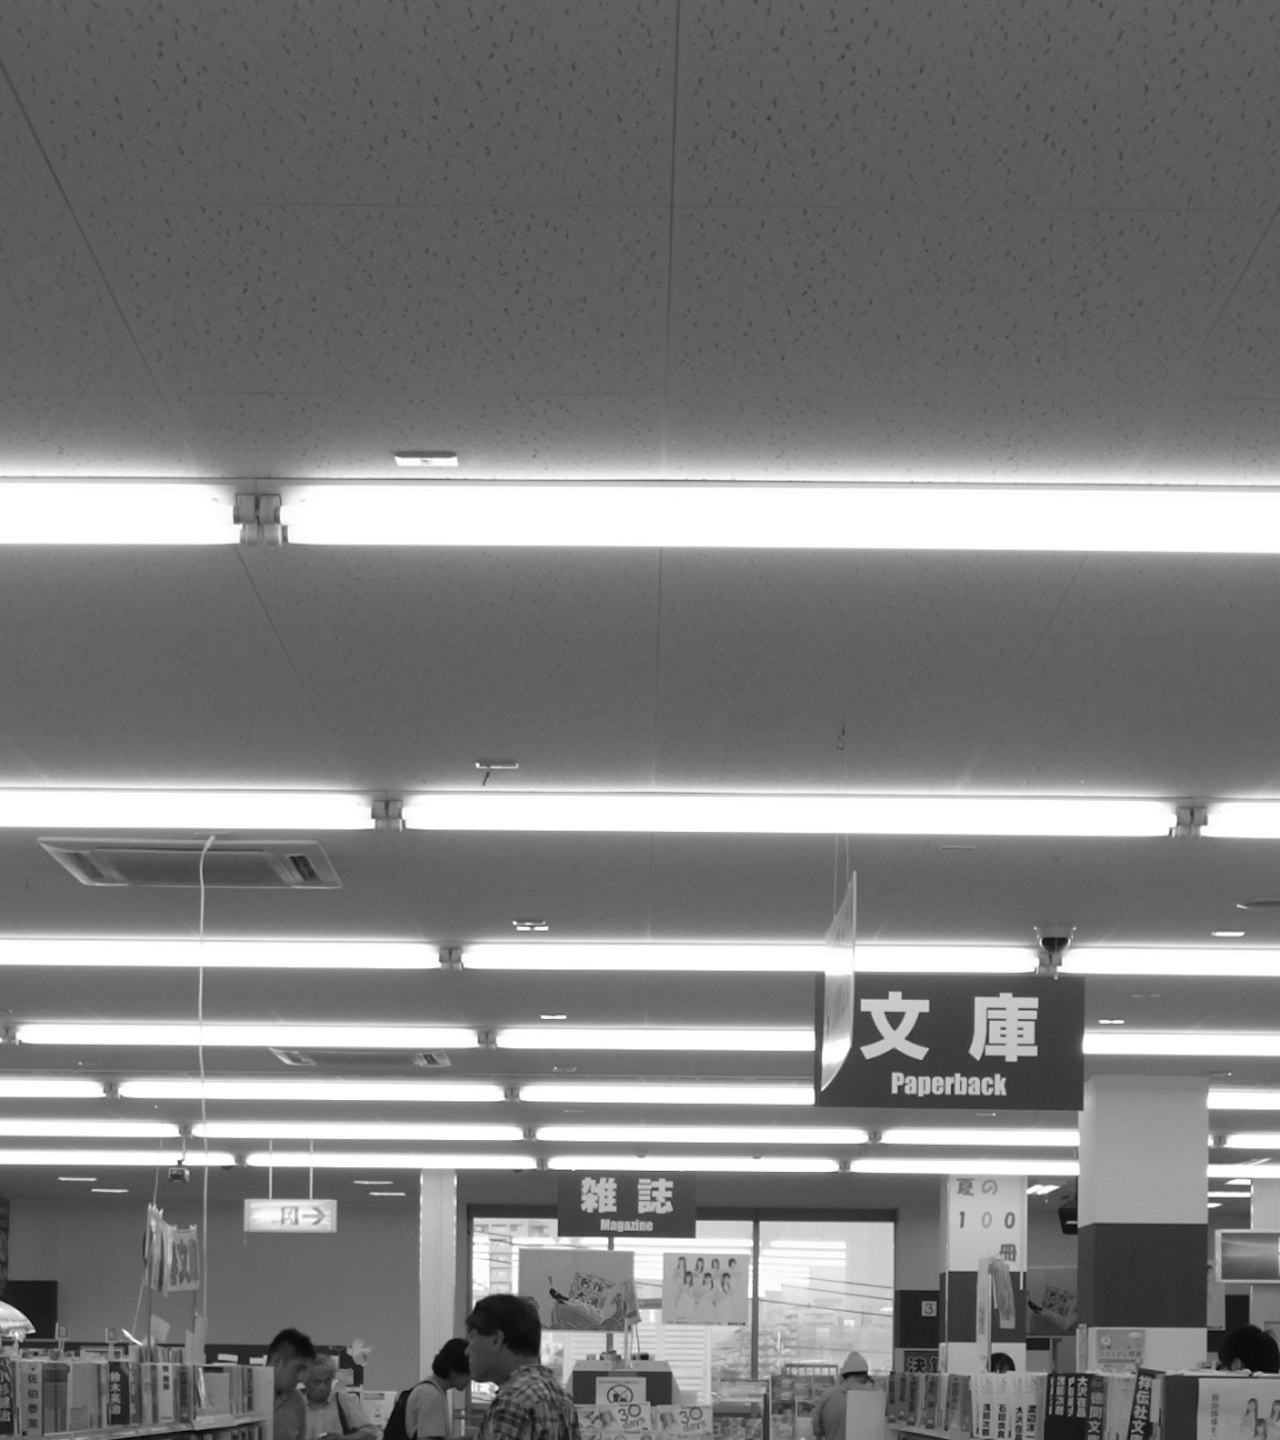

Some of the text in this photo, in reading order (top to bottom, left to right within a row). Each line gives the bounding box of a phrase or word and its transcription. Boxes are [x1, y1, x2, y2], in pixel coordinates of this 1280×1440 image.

[860, 990, 1040, 1063] 文庫
[891, 1071, 1008, 1100] Paperback
[580, 1176, 674, 1215] 雑誌
[956, 1177, 999, 1197] 夏の
[600, 1218, 654, 1233] Magazine
